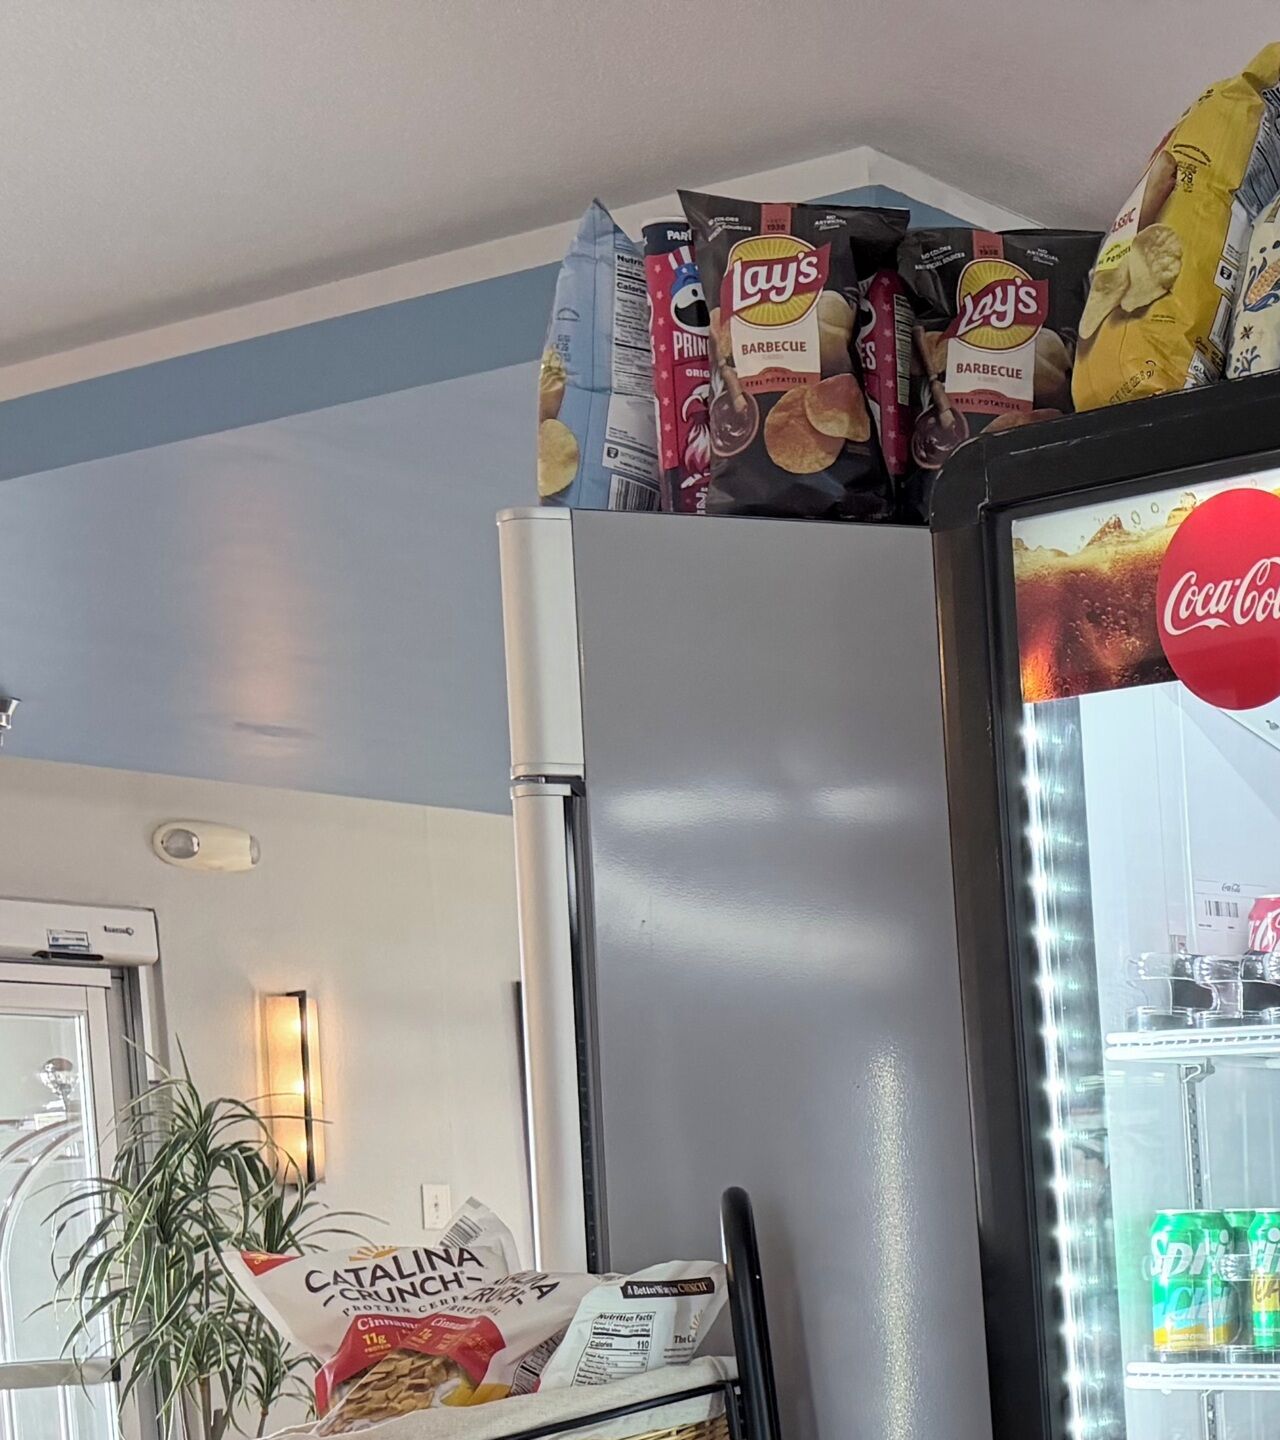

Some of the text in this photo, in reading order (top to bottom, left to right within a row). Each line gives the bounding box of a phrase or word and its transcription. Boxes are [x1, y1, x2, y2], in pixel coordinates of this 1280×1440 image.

[732, 252, 824, 307] Lay's
[959, 277, 1039, 332] Lay's
[741, 339, 807, 355] BARBECUE
[956, 364, 1023, 381] BARBECUE
[305, 1247, 487, 1294] CATALINA
[340, 1271, 462, 1304] CRUNCH
[343, 1303, 412, 1316] PROTEIN
[599, 1313, 634, 1321] Nutrition
[362, 1333, 387, 1345] 11g
[590, 1340, 649, 1349] Calories 110
